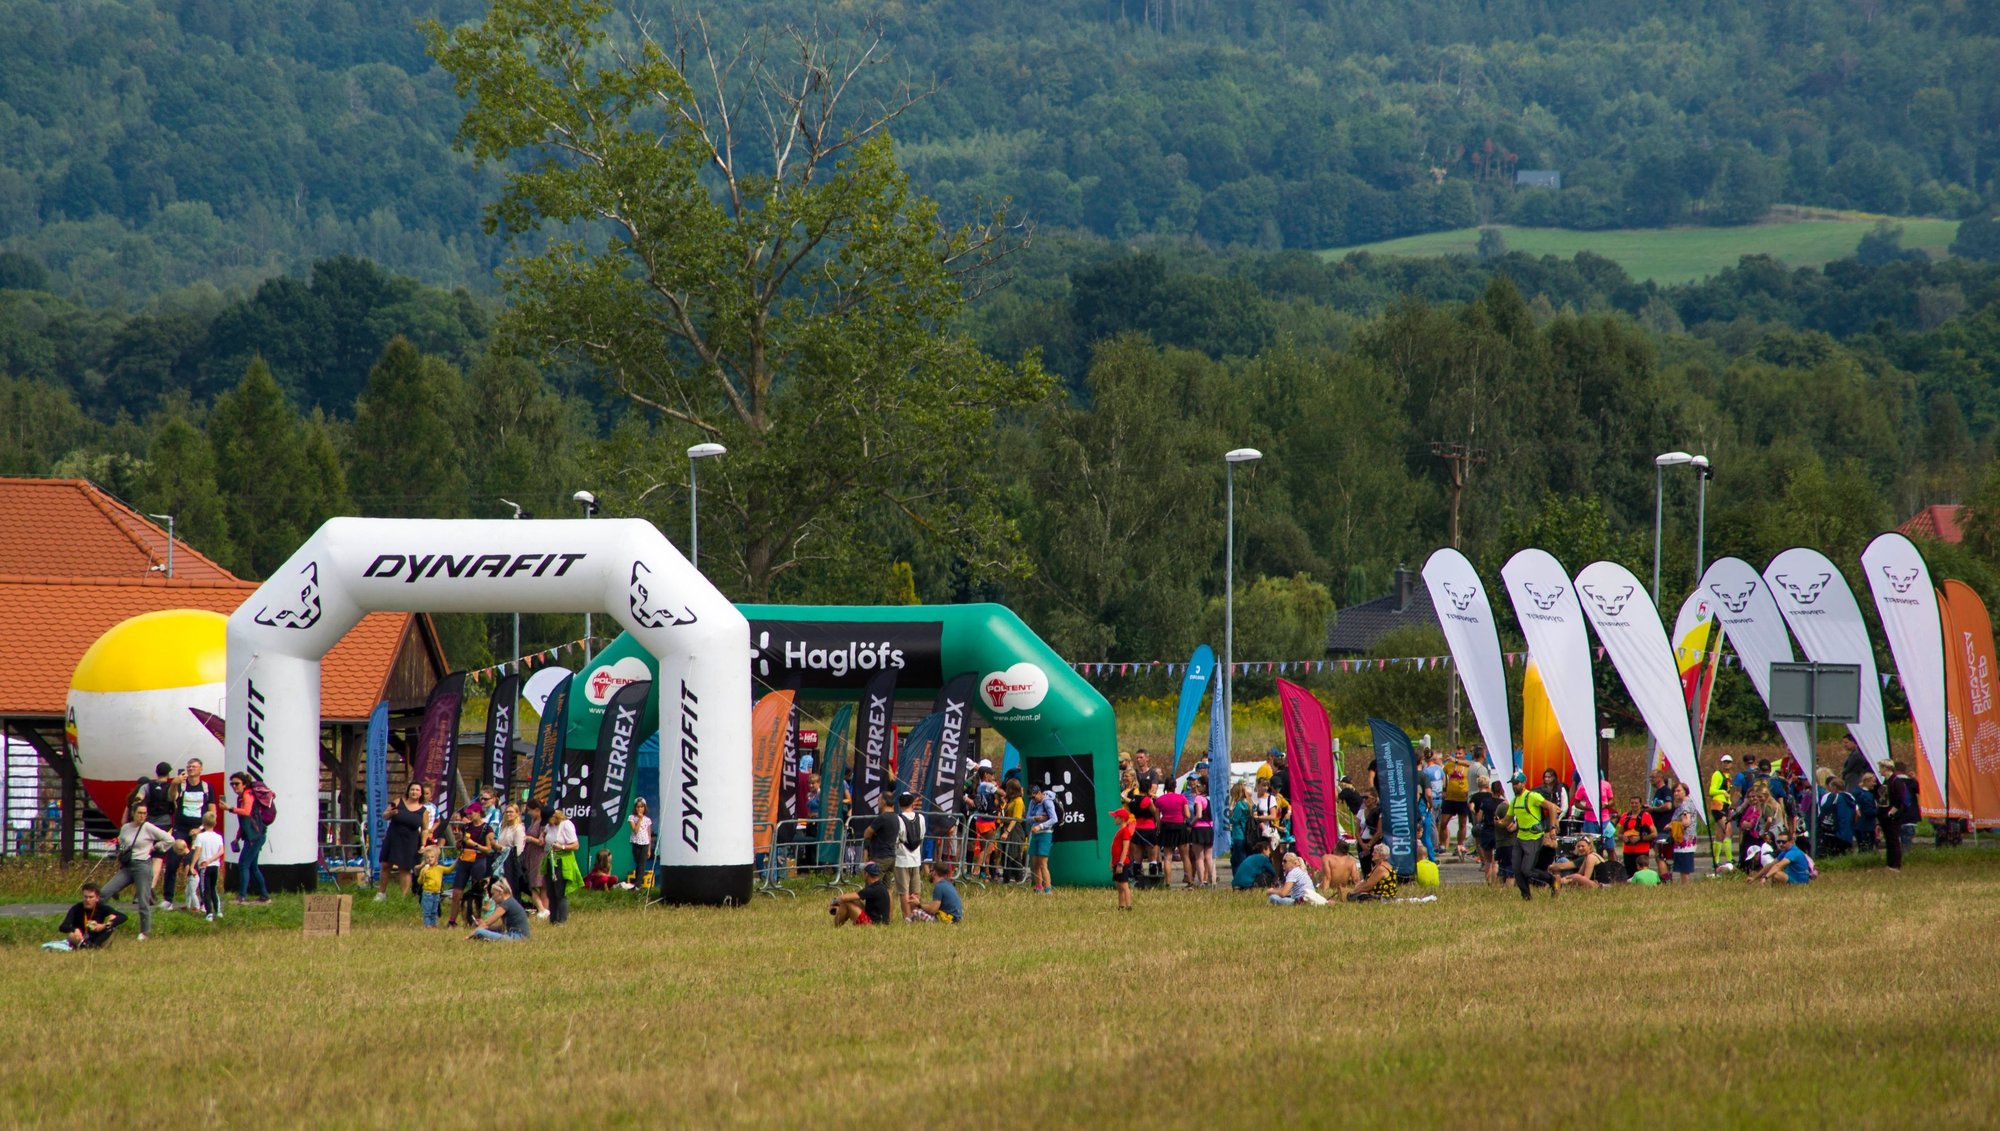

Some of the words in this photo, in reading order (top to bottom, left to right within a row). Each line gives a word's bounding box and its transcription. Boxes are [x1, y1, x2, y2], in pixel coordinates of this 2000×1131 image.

[362, 553, 587, 583] DYNAFIT
[785, 640, 905, 677] Haglöfs
[987, 684, 1032, 692] POLTENT
[247, 678, 265, 782] AFIT
[603, 704, 637, 792] TERREX
[679, 679, 703, 853] DYNAFIT
[783, 704, 798, 791] TERRE
[865, 694, 887, 784] TERREX
[935, 698, 966, 787] TERREX
